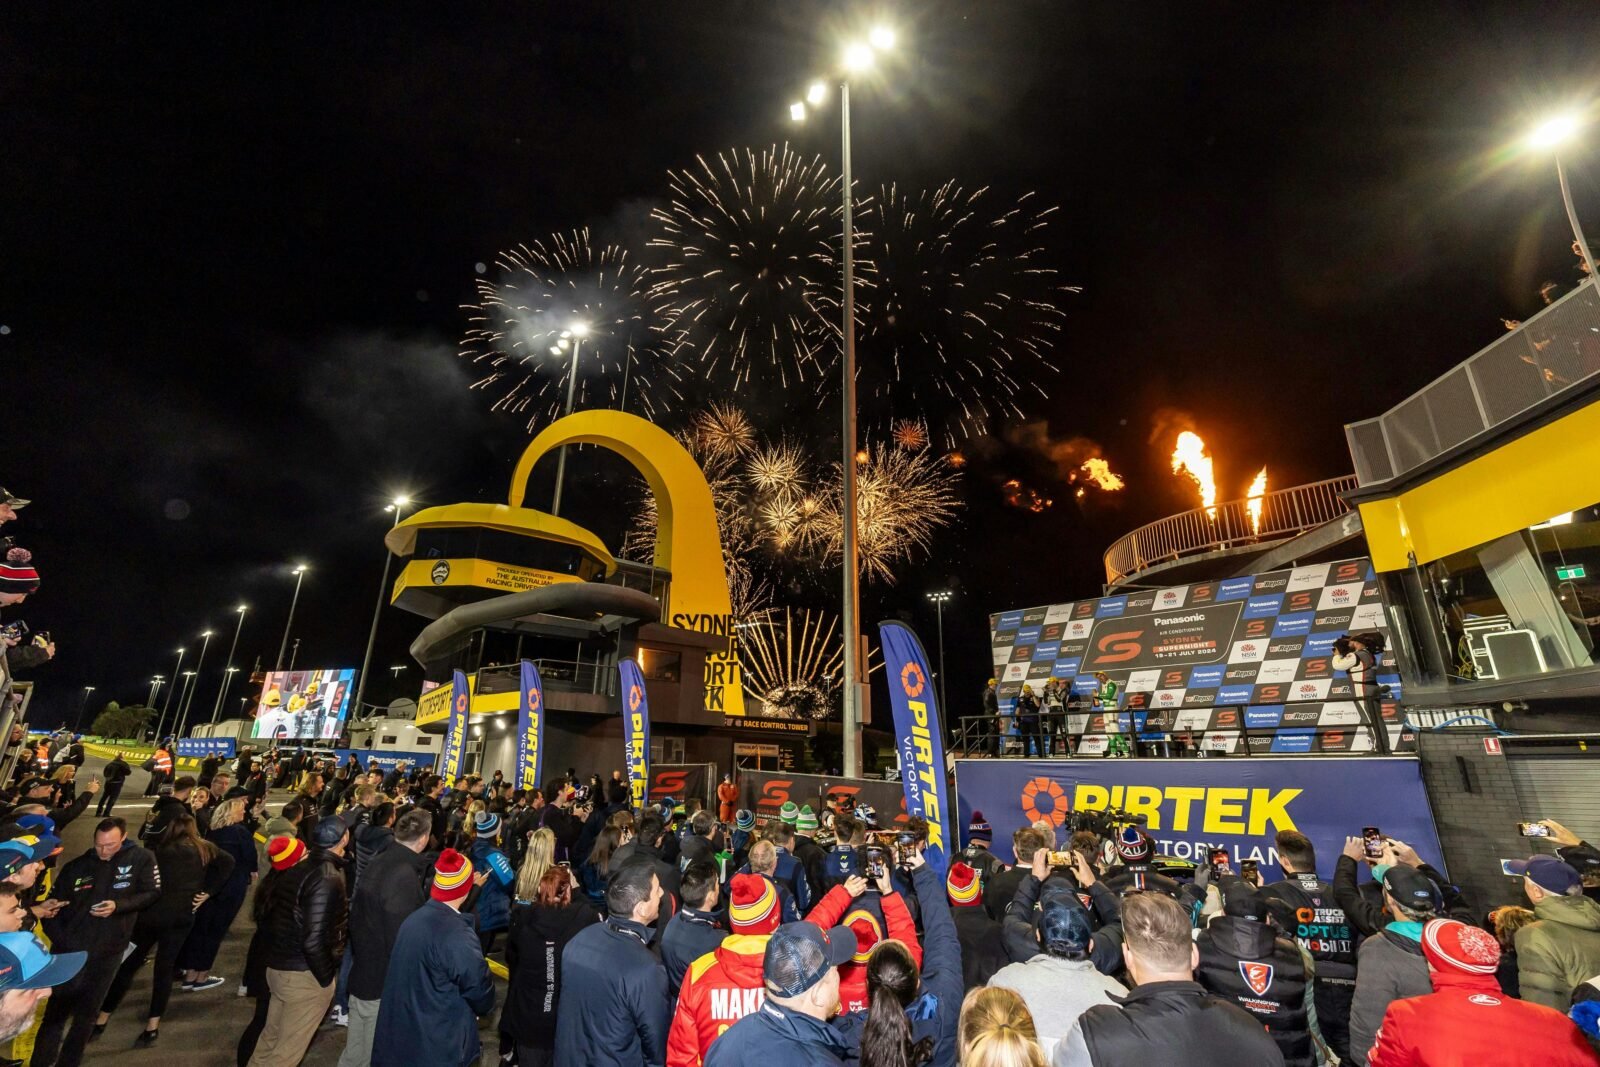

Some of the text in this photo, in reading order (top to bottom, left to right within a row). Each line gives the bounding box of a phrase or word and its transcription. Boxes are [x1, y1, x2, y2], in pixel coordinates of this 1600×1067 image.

[486, 577, 512, 588] RACING
[1153, 613, 1206, 627] Panasonic
[1162, 635, 1203, 645] SYDNEY
[1158, 641, 1210, 652] SUPERNIGHT
[1178, 649, 1196, 657] JULY
[1197, 647, 1217, 655] 2024
[743, 720, 760, 728] RACE
[760, 721, 787, 730] CONTROL
[788, 723, 809, 731] TOWER
[445, 713, 465, 789] PIRTEK
[903, 736, 920, 803] VICTORY
[907, 700, 944, 854] PIRTEK
[1073, 784, 1303, 836] PIRTEK
[1314, 908, 1345, 916] TRUCK
[1313, 916, 1345, 924] ASSIST
[1297, 924, 1350, 938] OPTUS
[1297, 937, 1337, 953] Mobil
[1237, 996, 1280, 1007] WALKINSHAW
